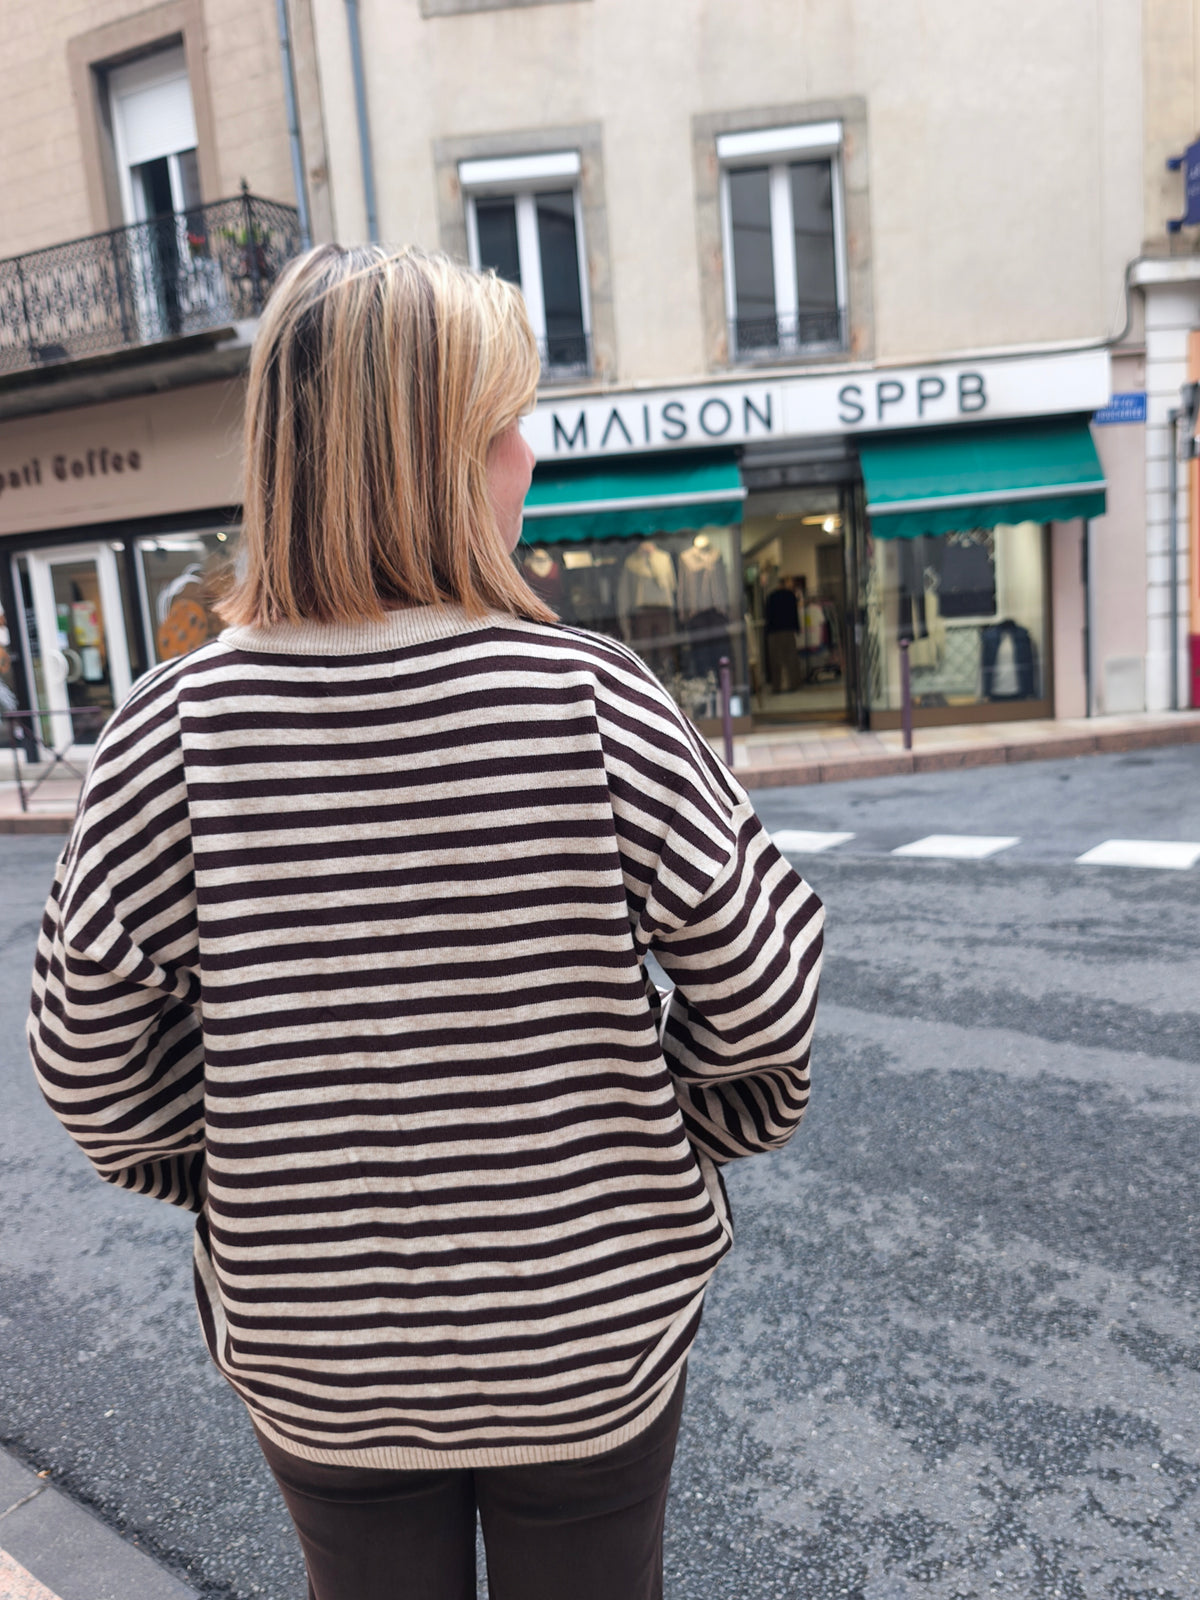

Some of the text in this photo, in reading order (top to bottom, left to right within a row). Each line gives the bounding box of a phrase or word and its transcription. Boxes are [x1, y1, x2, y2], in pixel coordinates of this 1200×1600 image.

[551, 372, 988, 452] MAISON SPPB
[53, 447, 142, 482] Coffee
